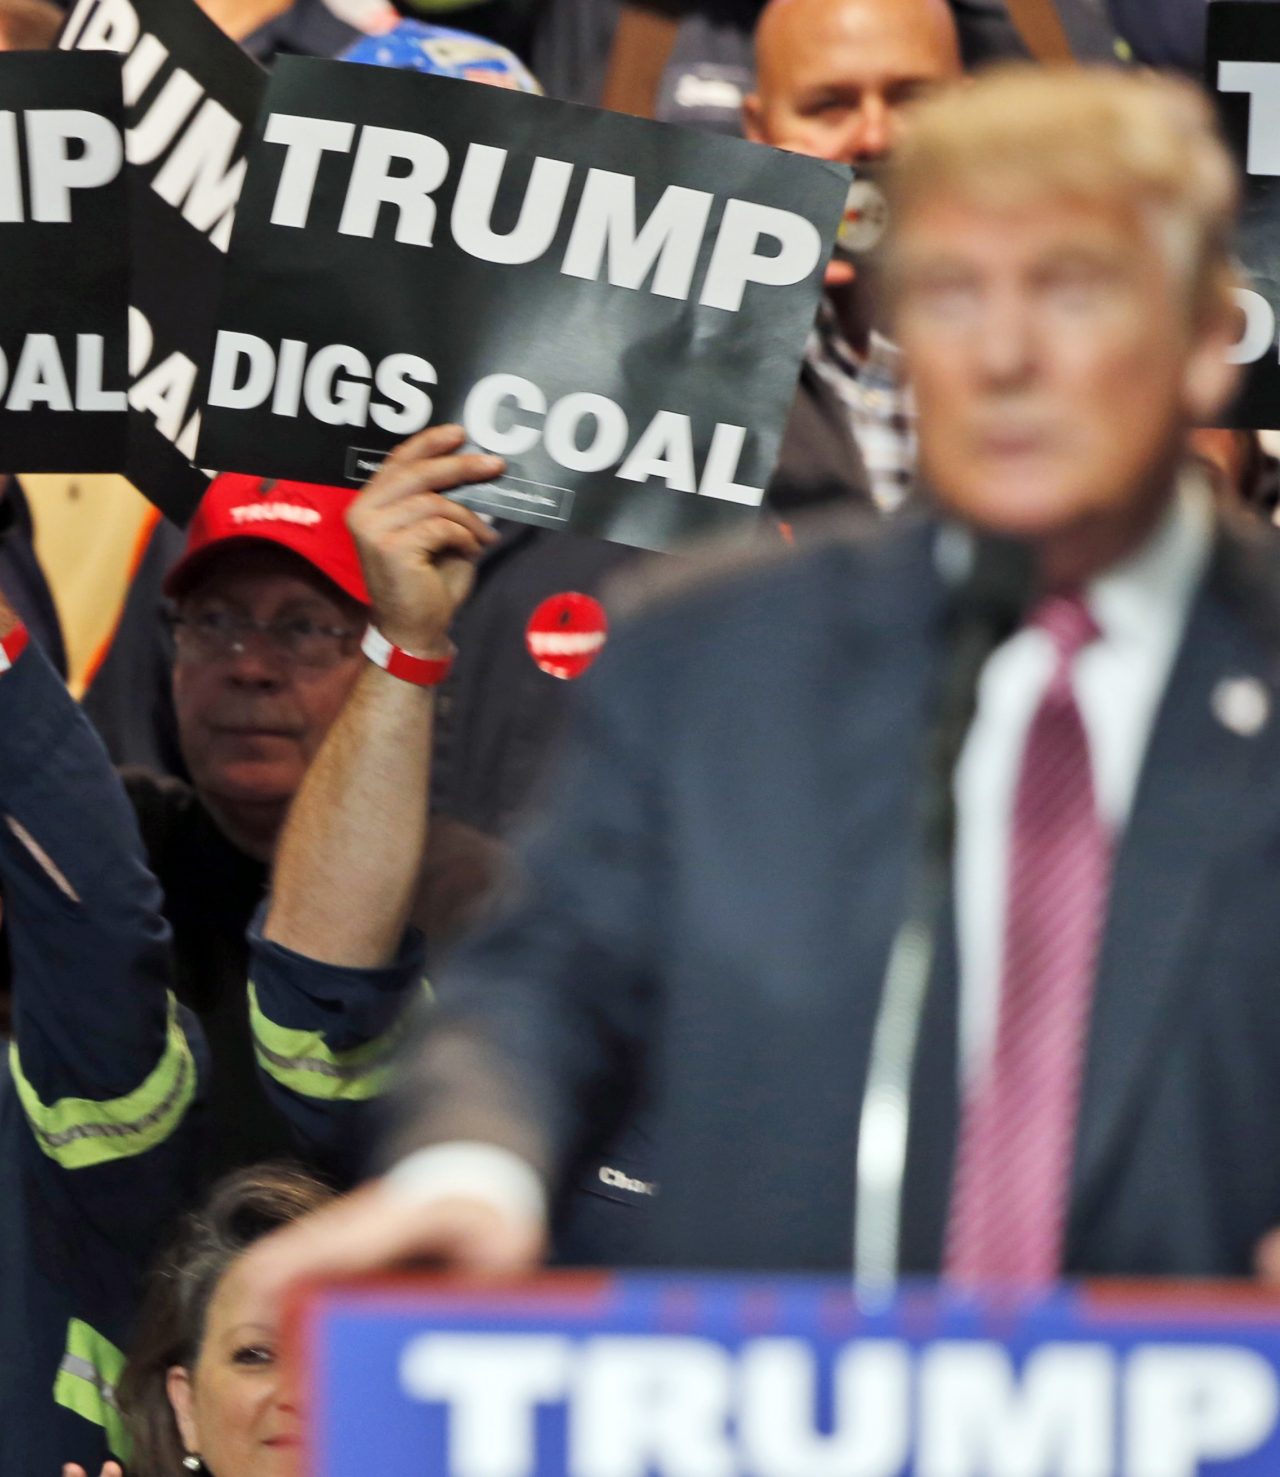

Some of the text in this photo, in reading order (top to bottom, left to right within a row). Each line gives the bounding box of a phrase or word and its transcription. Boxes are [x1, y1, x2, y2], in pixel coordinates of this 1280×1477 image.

[263, 113, 821, 312] TRUMP
[207, 330, 438, 435] DIGS
[463, 373, 764, 508] COAL
[398, 1333, 1278, 1477] TRUMP
